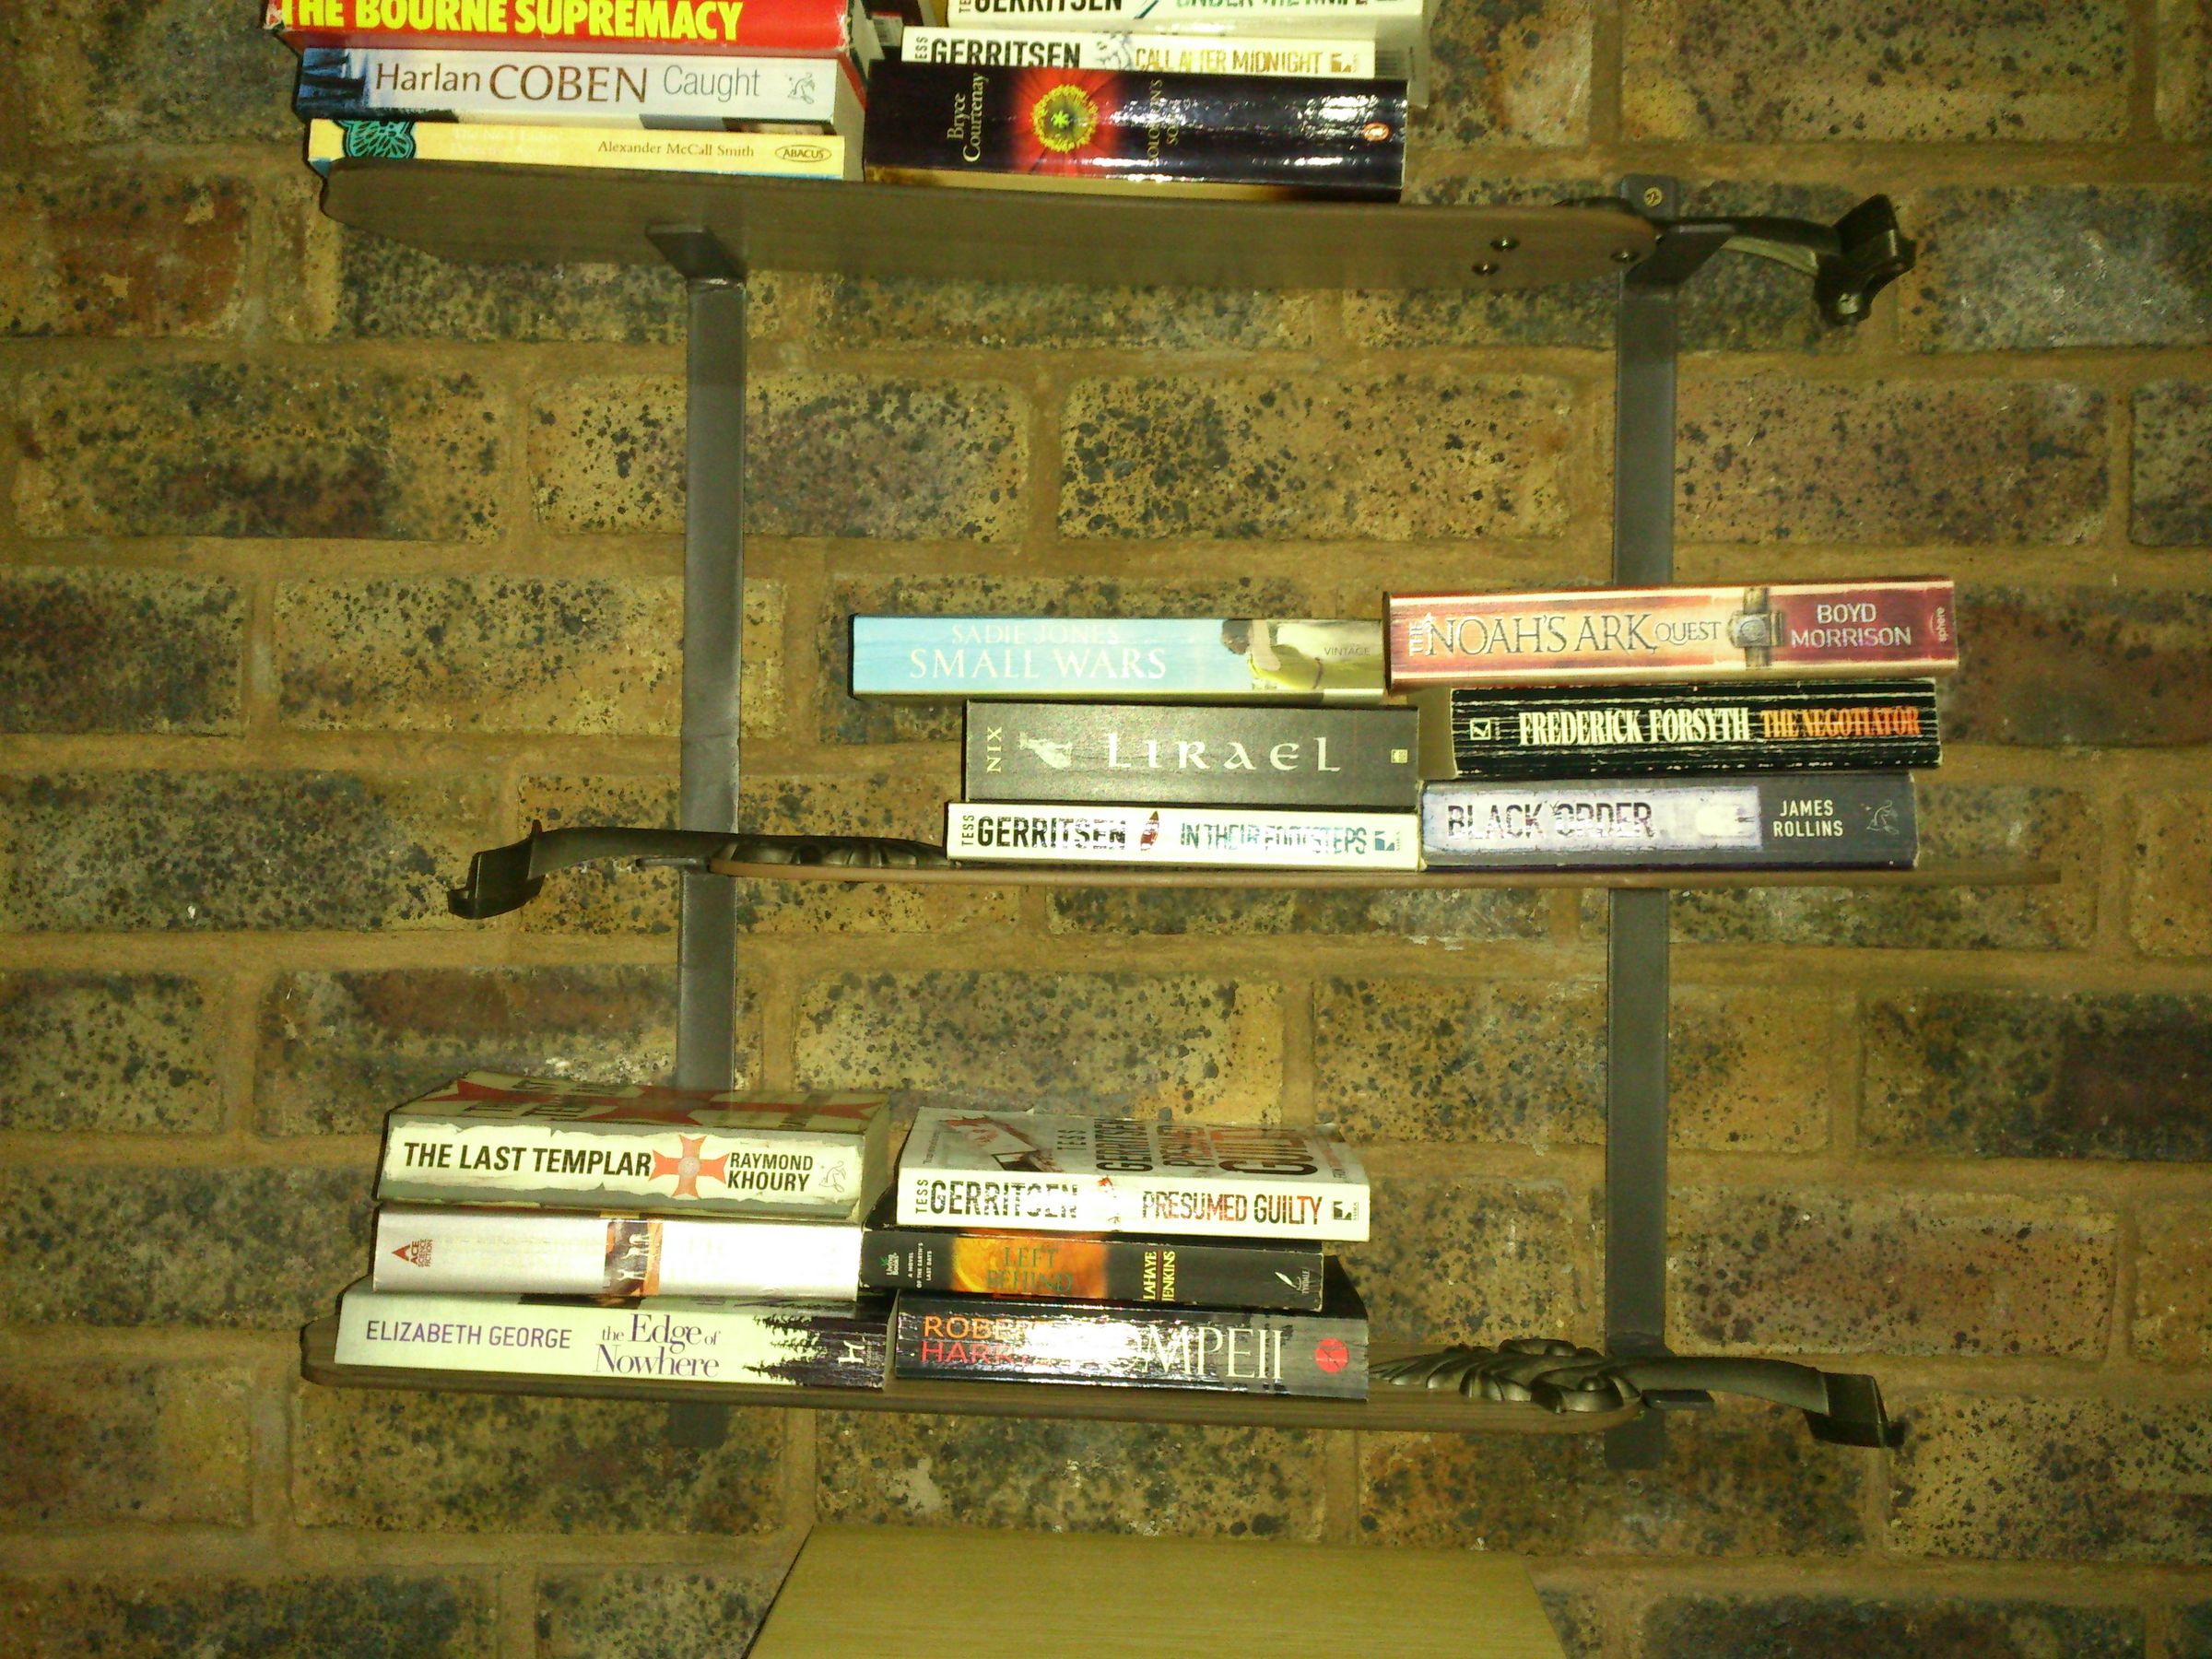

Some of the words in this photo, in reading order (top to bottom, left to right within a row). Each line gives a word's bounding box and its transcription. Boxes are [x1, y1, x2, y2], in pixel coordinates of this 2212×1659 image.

[279, 0, 345, 28] THE
[357, 0, 508, 34] BOURNE
[514, 0, 744, 41] SUPREMACY
[931, 38, 1081, 68] GERRITSEN
[1231, 49, 1324, 75] MIDNIGHT
[376, 62, 481, 92] Harlan
[488, 64, 648, 103] COBEN
[663, 65, 761, 103] Caught
[947, 91, 966, 140] Bryce
[962, 72, 990, 163] Courtenay
[597, 140, 662, 155] Alexander
[665, 142, 712, 157] McCall
[716, 144, 755, 158] Smith
[782, 147, 825, 159] ABACUS
[1816, 602, 1877, 625] BOYD
[951, 624, 1026, 644] SADIE
[1035, 624, 1121, 645] JONES
[1408, 620, 1424, 657] THE
[1425, 612, 1568, 656] NOAH'S
[1573, 613, 1659, 655] ARK
[1654, 620, 1723, 646] QUEST
[1790, 626, 1912, 649] MORRISON
[909, 648, 1041, 679] SMALL
[1051, 648, 1167, 680] WARS
[1324, 646, 1371, 657] VINTAGE
[1518, 708, 1645, 747] FREDERICK
[1648, 706, 1751, 744] FORSYTH
[1759, 708, 1799, 738] THE
[1800, 704, 1922, 738] NEGOTIATOR
[986, 725, 1004, 774] NIX
[1447, 802, 1545, 840] BLACK
[1555, 801, 1656, 839] ORDER
[1779, 799, 1834, 818] JAMES
[961, 814, 975, 847] TESS
[977, 815, 1126, 850] GERRITSEN
[1180, 822, 1200, 850] IN
[1772, 819, 1844, 838] ROLLINS
[403, 1141, 453, 1169] THE
[459, 1144, 527, 1171] LAST
[532, 1147, 652, 1177] TEMPLAR
[729, 1152, 814, 1171] RAYMOND
[727, 1170, 811, 1193] KHOURY
[914, 1179, 929, 1214] TESS
[1142, 1190, 1248, 1222] PRESUMED
[1253, 1194, 1323, 1226] GUILTY
[1003, 1246, 1059, 1269] LEFT
[986, 1269, 1073, 1292] BEHIND
[1142, 1251, 1158, 1300] LAHAYE
[1161, 1250, 1176, 1301] JENKINS
[365, 1320, 482, 1346] ELIZABETH
[488, 1325, 573, 1349] GEORGE
[602, 1325, 625, 1342] the
[627, 1312, 702, 1354] Edge
[704, 1330, 722, 1346] of
[592, 1343, 720, 1378] Nowhere
